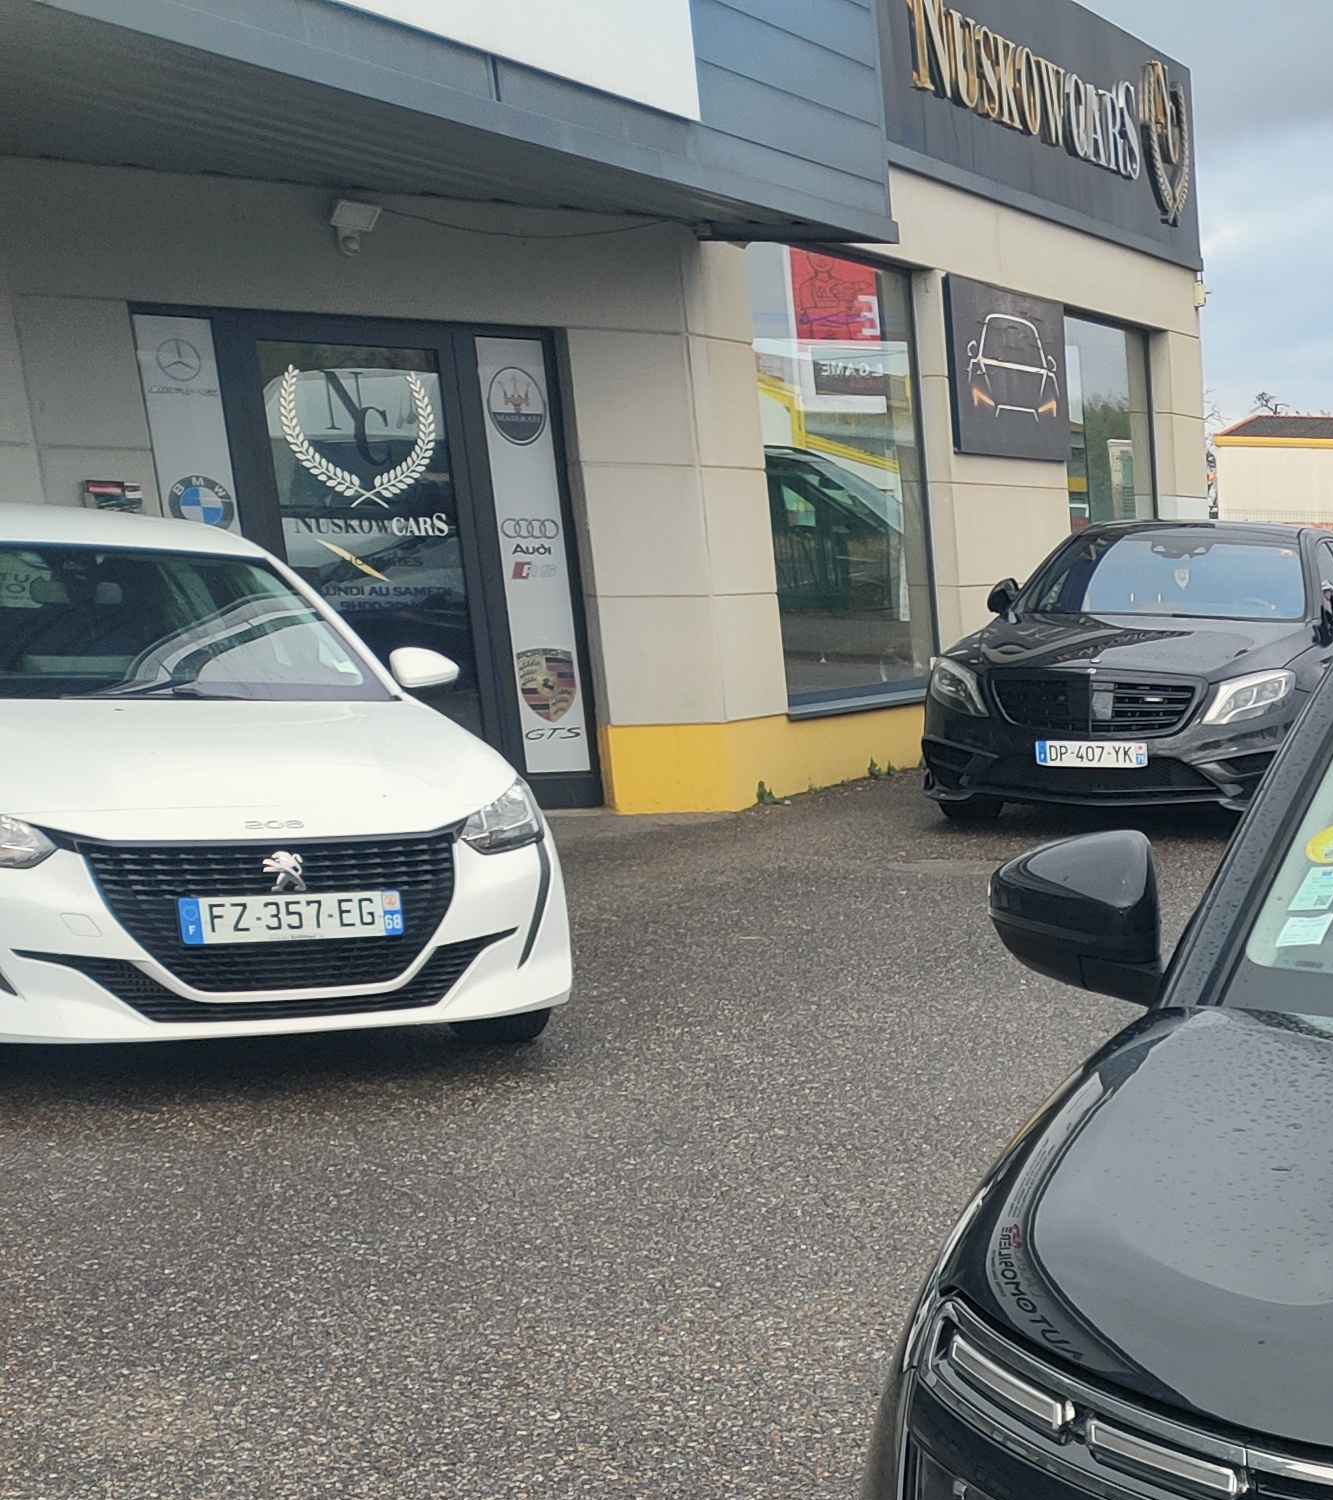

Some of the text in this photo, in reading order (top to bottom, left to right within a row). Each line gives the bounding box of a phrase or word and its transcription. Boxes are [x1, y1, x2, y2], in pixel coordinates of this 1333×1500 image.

[172, 476, 227, 497] BMW
[512, 543, 552, 556] Audi
[368, 586, 390, 597] AU
[525, 727, 581, 741] GTS
[1048, 744, 1134, 763] DP-407-YK
[244, 820, 305, 830] 208
[187, 897, 401, 936] F FZ-357-EG 68
